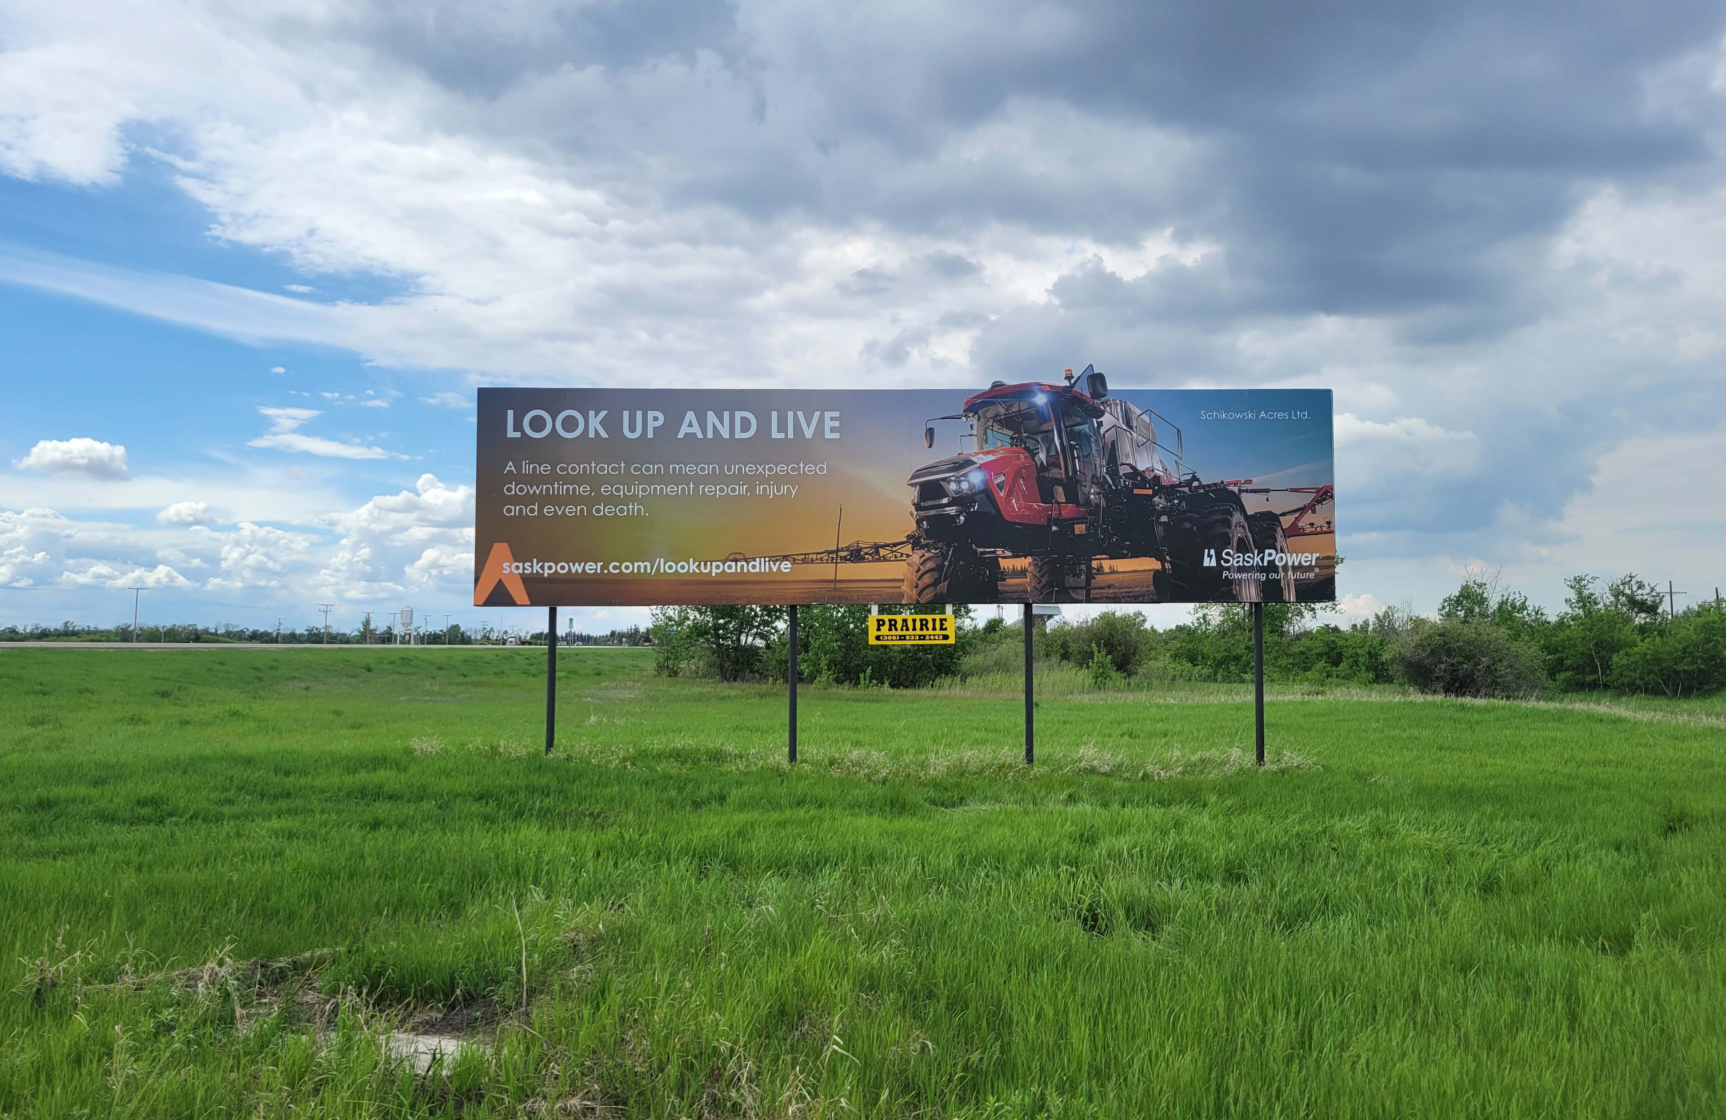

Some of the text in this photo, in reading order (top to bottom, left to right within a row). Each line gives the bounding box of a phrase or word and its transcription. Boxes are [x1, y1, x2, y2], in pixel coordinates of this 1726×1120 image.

[506, 409, 841, 439] LOOK UP AND LIVE
[1200, 410, 1311, 420] Schikowski Acres Ltd.
[503, 460, 827, 479] A line contact can mean unexpected
[503, 481, 799, 499] downtime, equipment repair, injury
[503, 502, 650, 516] and even death.
[502, 557, 792, 577] saskpower.com/lookupandlive
[1220, 549, 1320, 567] SaskPower
[1222, 571, 1266, 581] Powering
[876, 618, 948, 631] PRAIRIE
